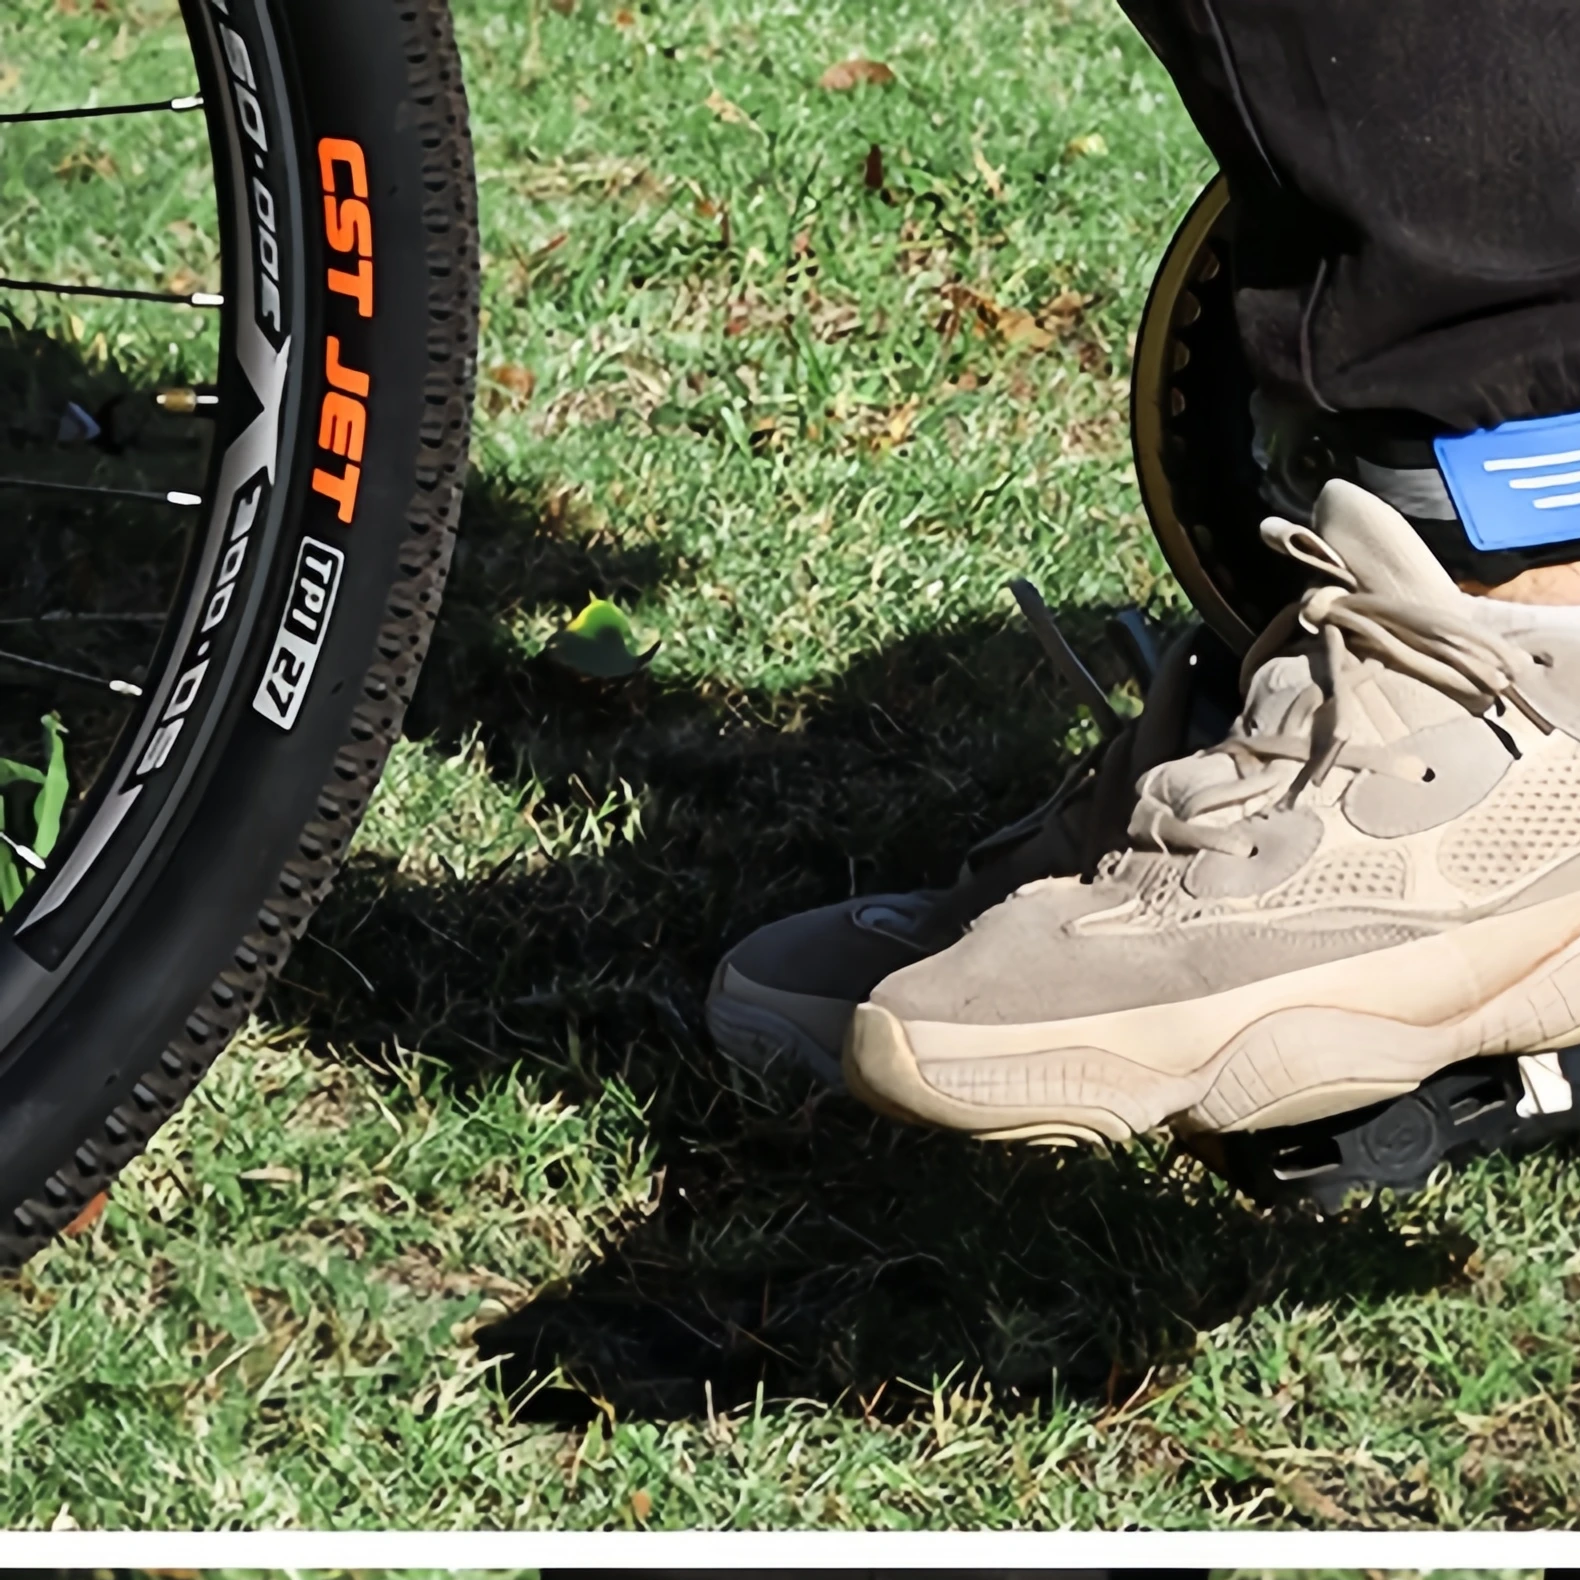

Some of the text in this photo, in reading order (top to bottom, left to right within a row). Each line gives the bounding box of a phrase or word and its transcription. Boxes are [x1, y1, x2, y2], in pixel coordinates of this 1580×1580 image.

[312, 137, 373, 524] CST JET
[265, 555, 334, 719] TPI 27
